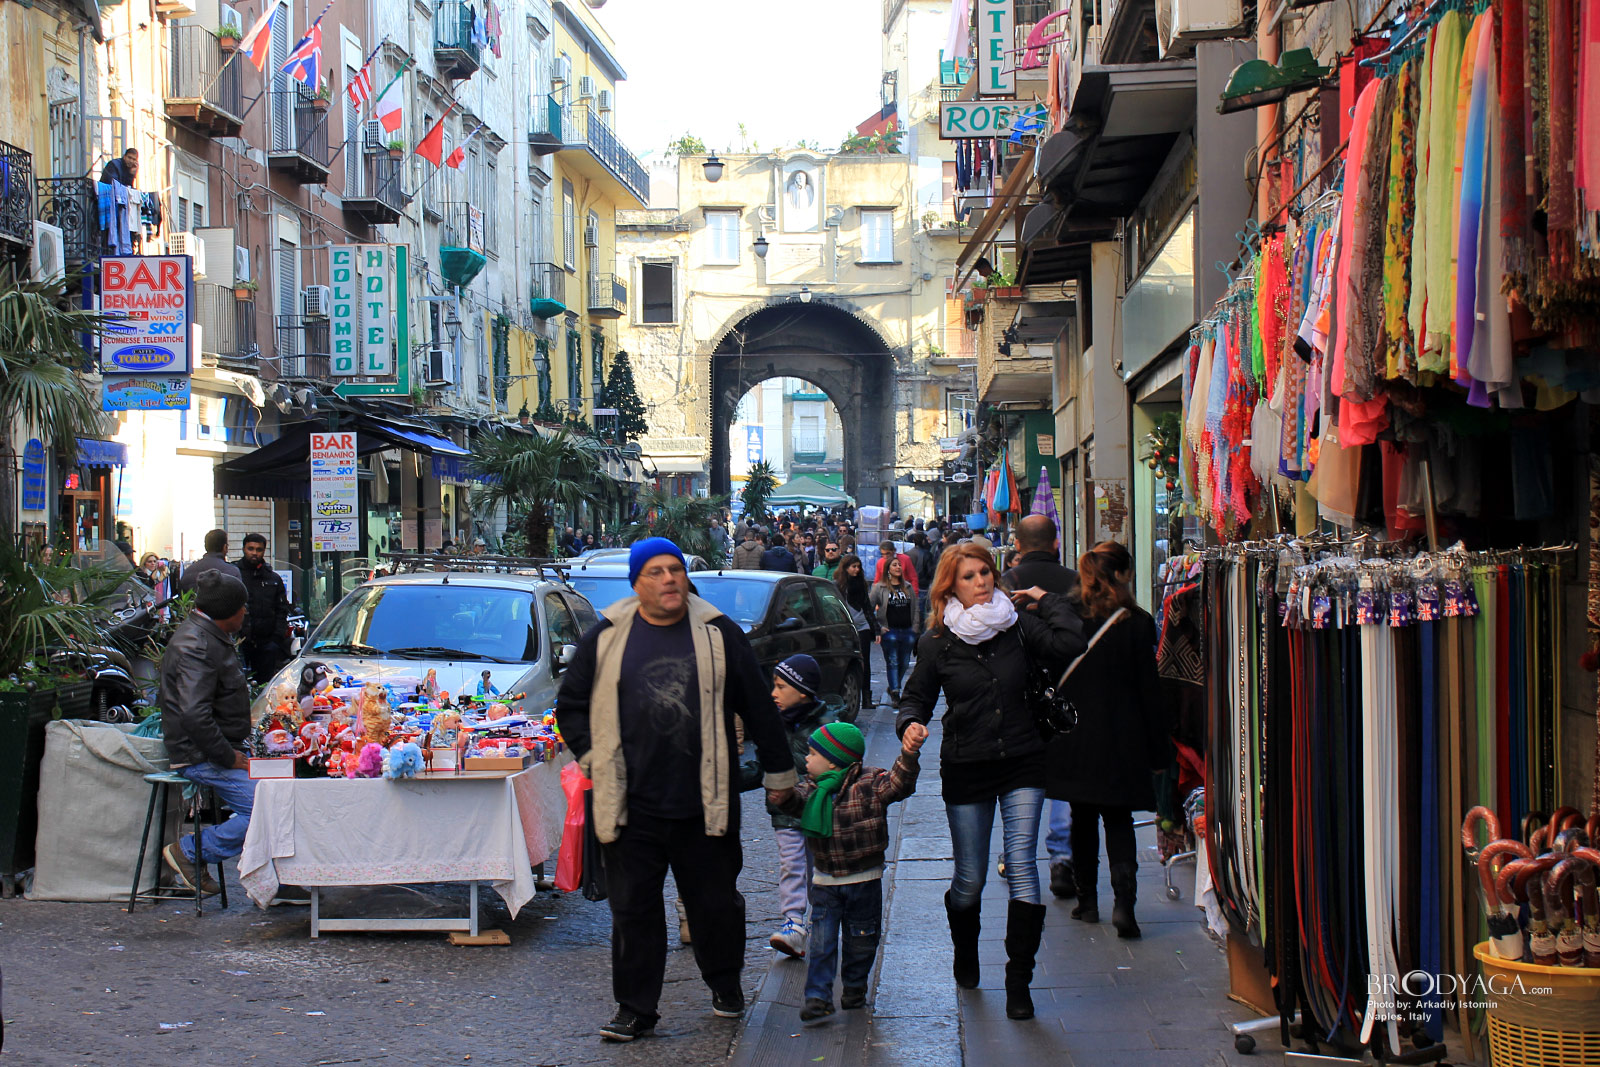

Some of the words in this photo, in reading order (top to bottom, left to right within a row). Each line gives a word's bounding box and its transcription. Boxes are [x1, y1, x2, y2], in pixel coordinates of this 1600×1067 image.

[985, 0, 1007, 89] TEL
[103, 259, 185, 291] BAR
[104, 293, 185, 309] BENIAMINO
[333, 251, 352, 371] COLOMBO
[367, 250, 384, 370] HOTEL
[148, 322, 182, 335] SKY
[104, 336, 141, 344] SCOMMESSE
[143, 336, 185, 344] TELEMATICHE
[118, 354, 171, 364] TORALDO
[312, 434, 354, 450] BAR
[313, 451, 355, 459] BENIAMINO
[336, 467, 355, 475] SKY
